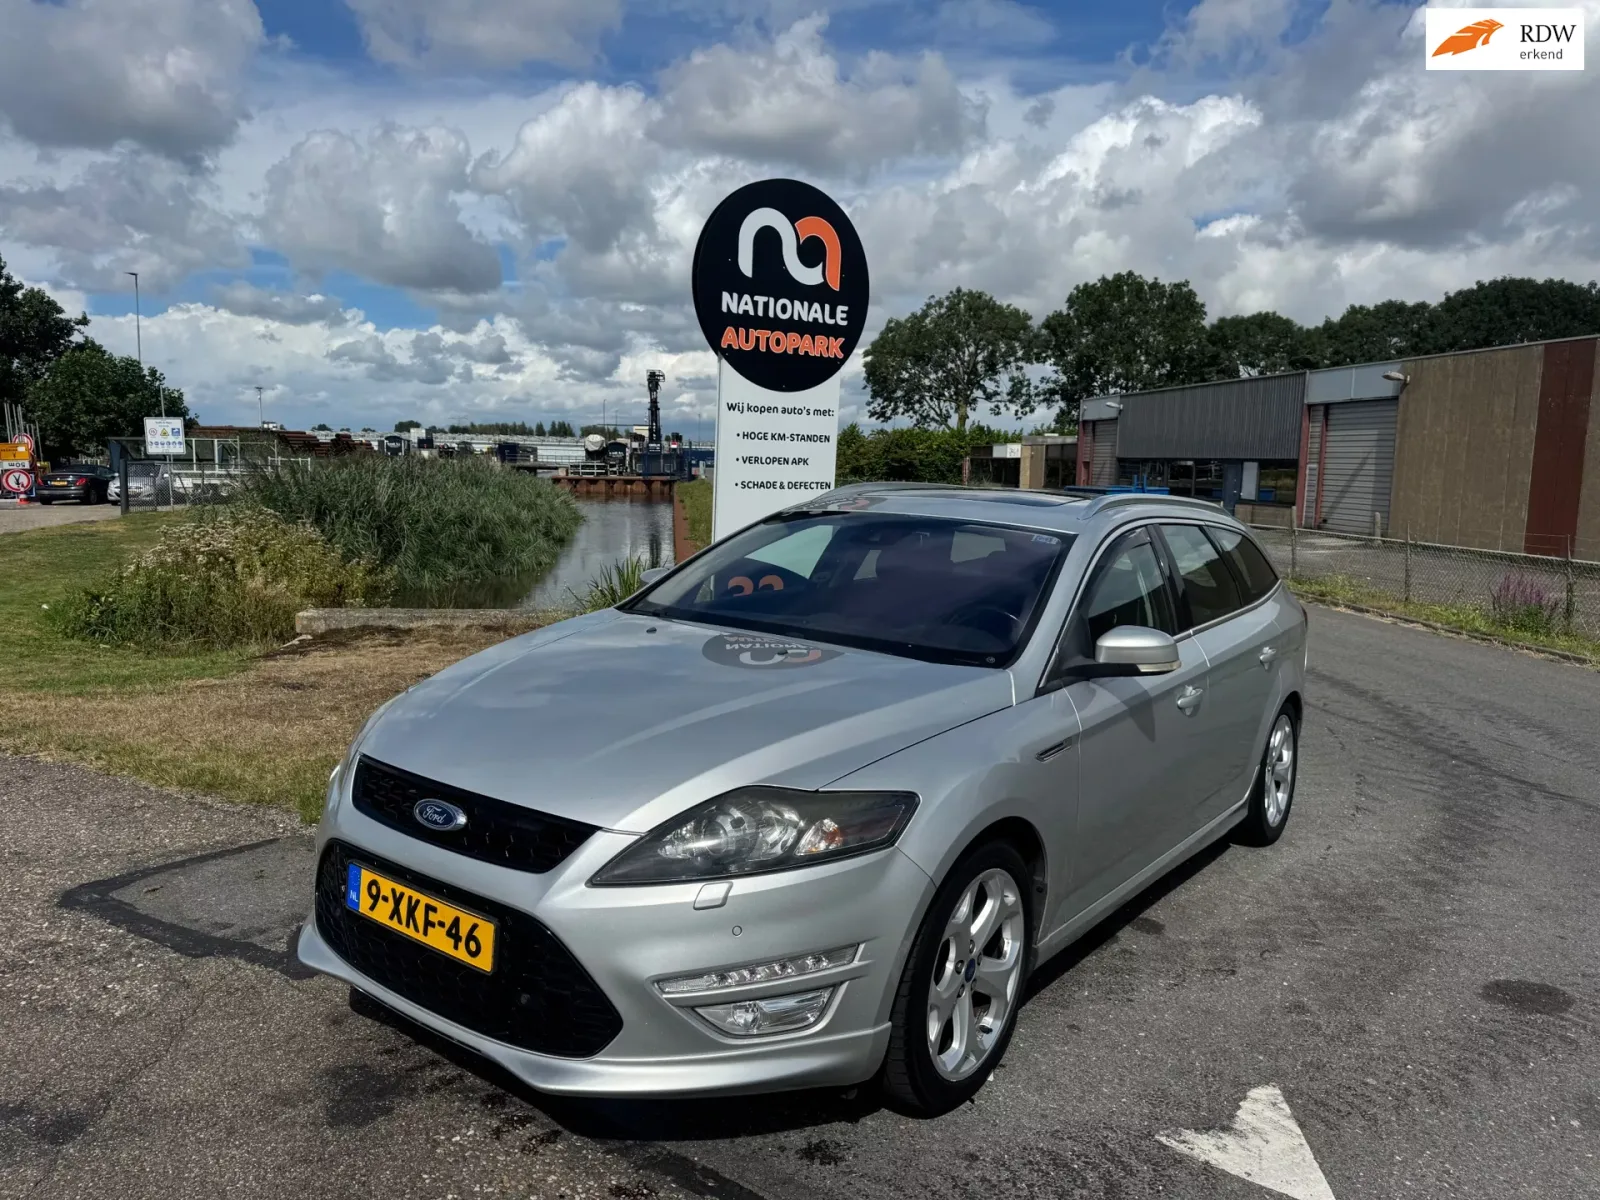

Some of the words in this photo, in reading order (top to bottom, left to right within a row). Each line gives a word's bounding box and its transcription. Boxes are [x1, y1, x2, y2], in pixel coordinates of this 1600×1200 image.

[721, 291, 849, 326] NATIONALE
[721, 326, 845, 359] AUTOPARK
[726, 402, 744, 414] Wij
[747, 403, 778, 415] kopen
[781, 406, 811, 416] auto's
[813, 408, 835, 417] met:
[742, 431, 769, 441] HOGE
[770, 432, 830, 443] KM-STANDEN
[741, 456, 789, 465] VERLOPEN
[791, 457, 809, 466] APK
[740, 481, 777, 490] SCHADE
[779, 482, 785, 490] &
[787, 481, 831, 490] DEFECTEN
[423, 805, 447, 824] Ford
[350, 889, 359, 902] NL
[366, 878, 482, 959] 9-XKF-46
